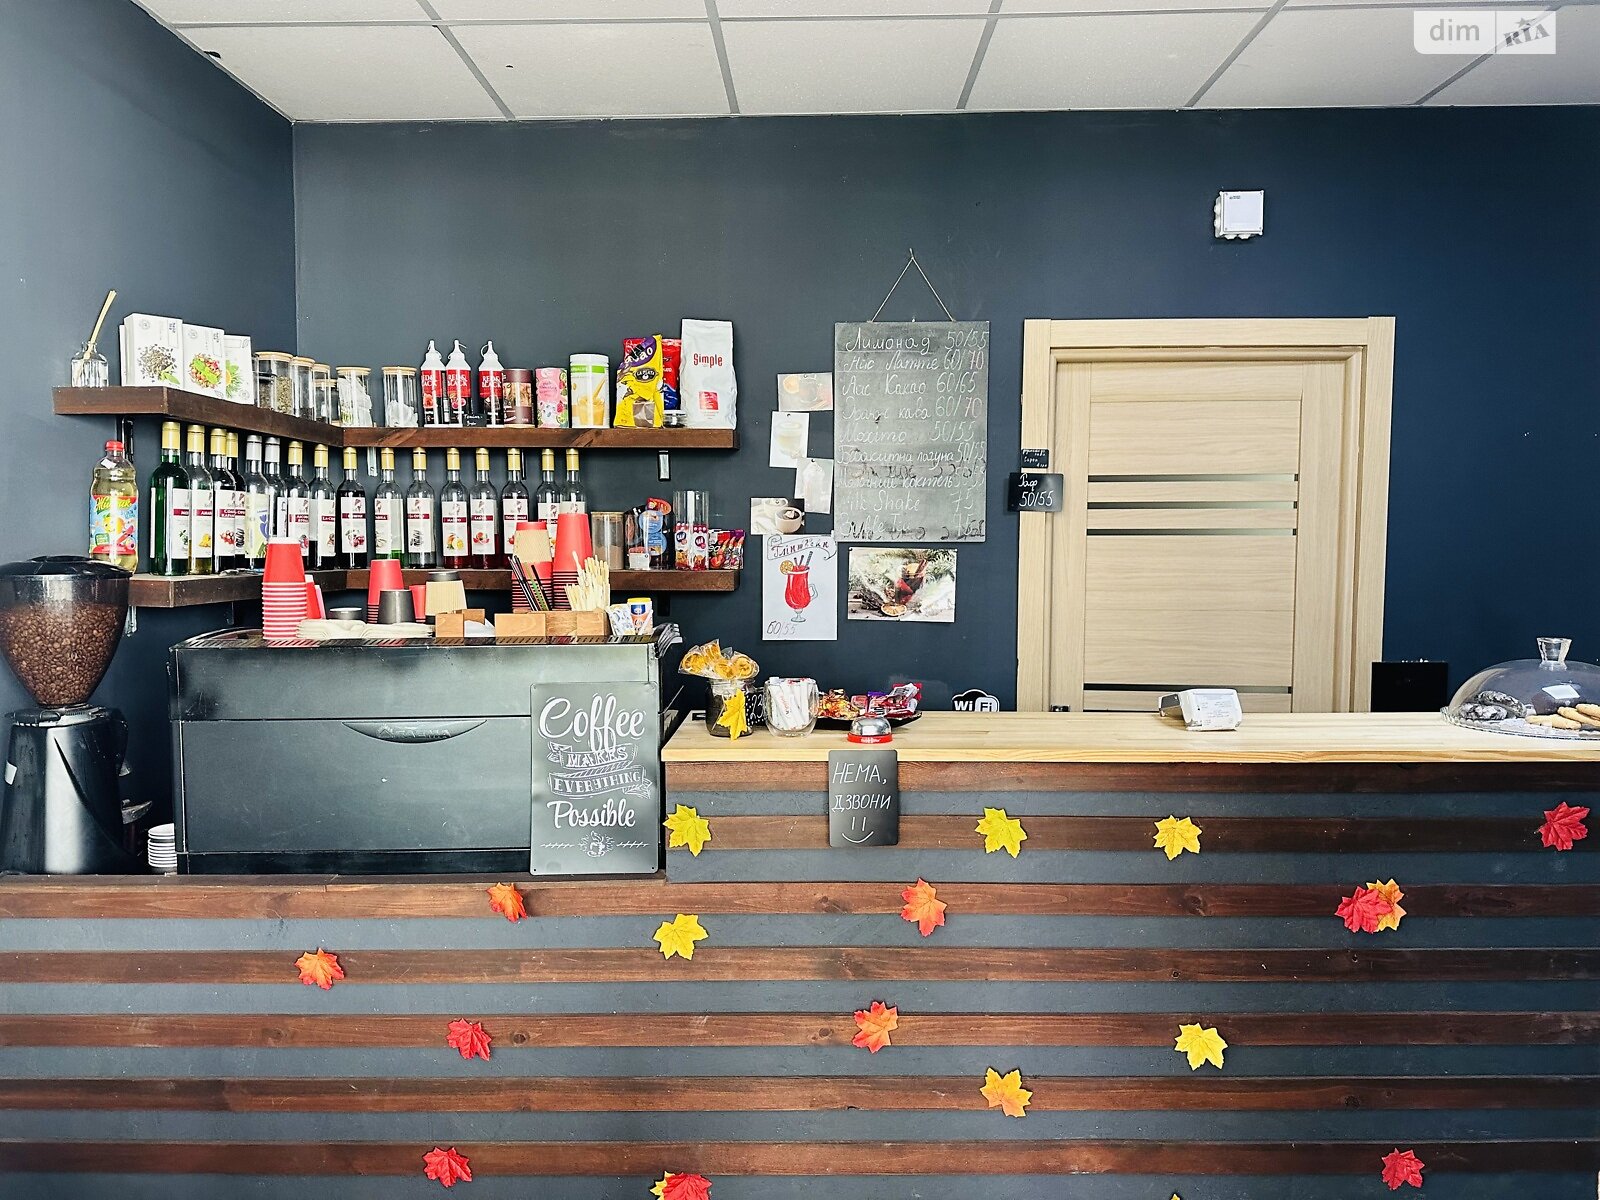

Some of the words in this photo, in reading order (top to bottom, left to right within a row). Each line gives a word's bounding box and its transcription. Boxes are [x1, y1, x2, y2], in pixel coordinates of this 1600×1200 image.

[845, 327, 930, 355] Лимонад
[944, 328, 989, 350] 50/55
[693, 353, 723, 369] Simple
[885, 350, 940, 371] Латте
[884, 373, 927, 395] Какао
[936, 372, 978, 394] 60/65
[935, 395, 983, 418] 60/70
[931, 420, 977, 442] 50/55
[874, 489, 920, 512] Shake
[950, 488, 974, 512] 75
[1018, 490, 1054, 507] 50/55
[538, 693, 646, 752] Coffee
[566, 747, 629, 768] MAKES
[554, 771, 642, 793] EVERYTHING
[832, 763, 888, 784] НЕМА,
[546, 798, 636, 829] Possible
[832, 795, 891, 813] ДЗВОНИ
